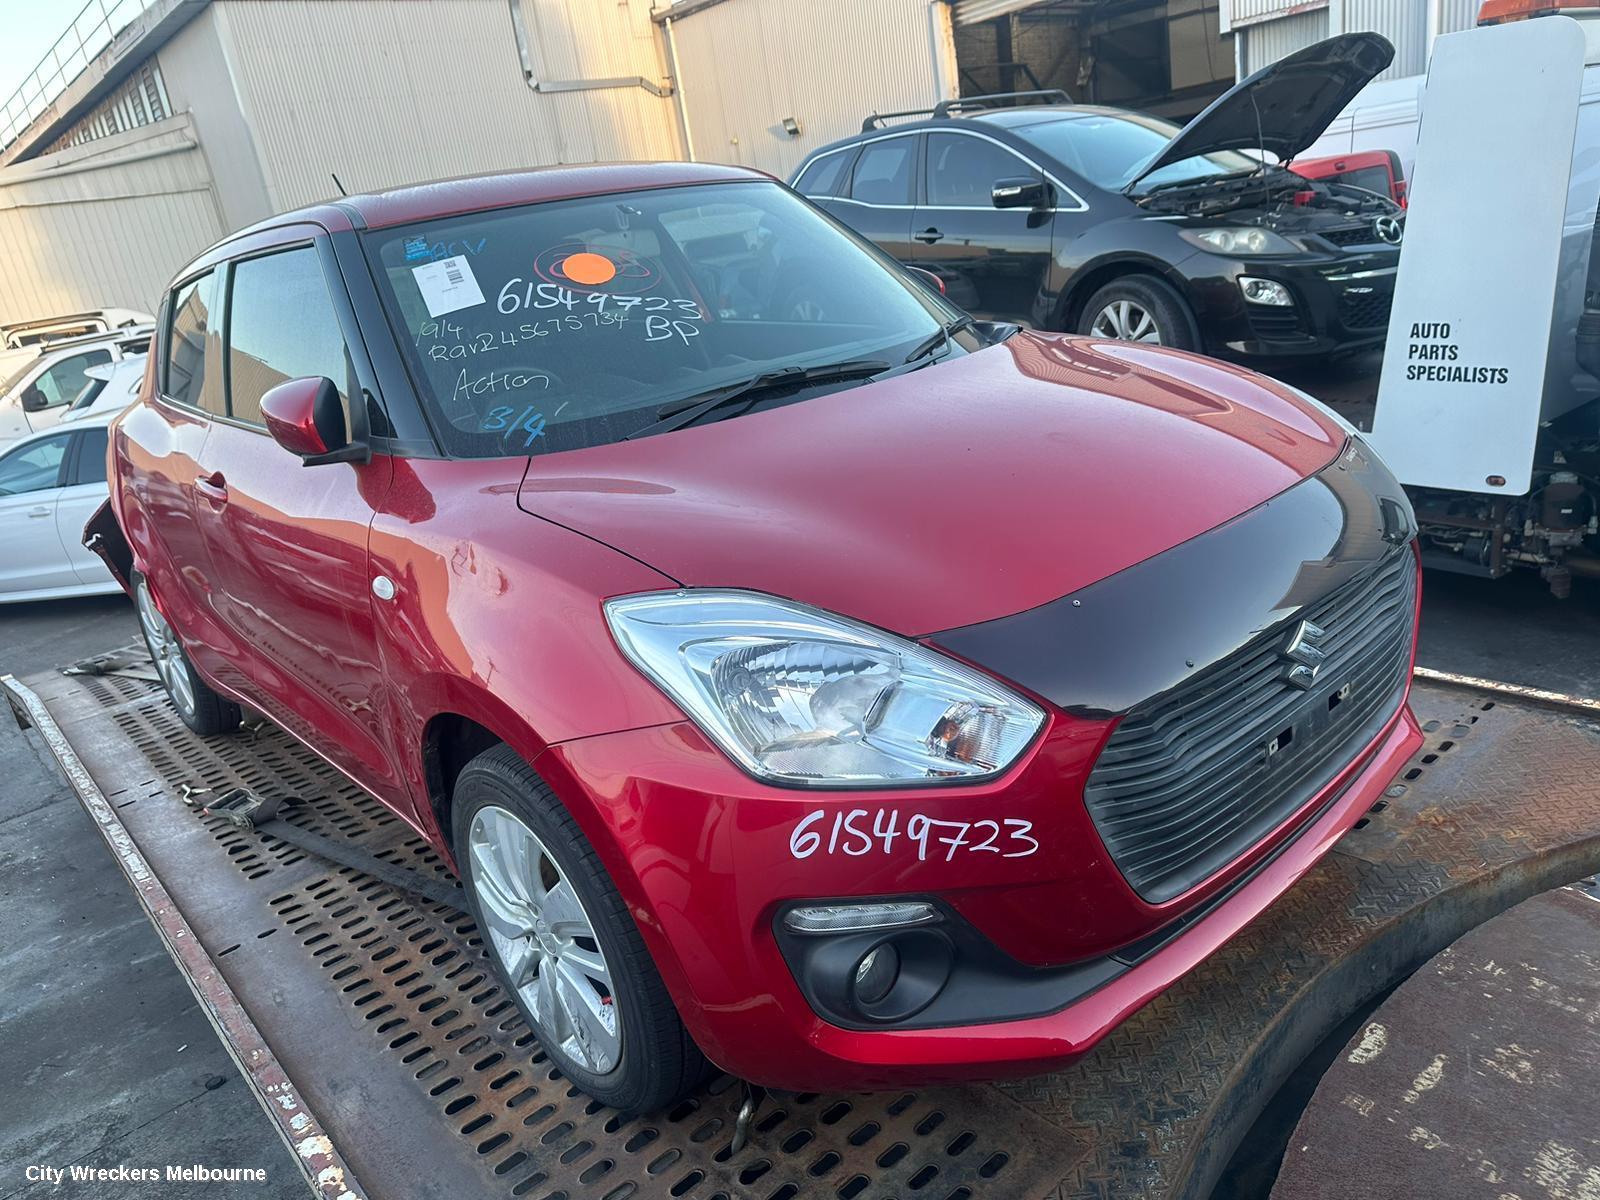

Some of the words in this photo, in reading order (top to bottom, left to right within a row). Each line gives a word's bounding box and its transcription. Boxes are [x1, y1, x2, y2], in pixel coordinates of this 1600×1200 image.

[497, 278, 702, 319] 61549723
[1409, 322, 1451, 339] AUTO
[1408, 344, 1459, 361] PARTS
[1406, 364, 1509, 384] SPECIALISTS
[789, 808, 1039, 862] 61549723
